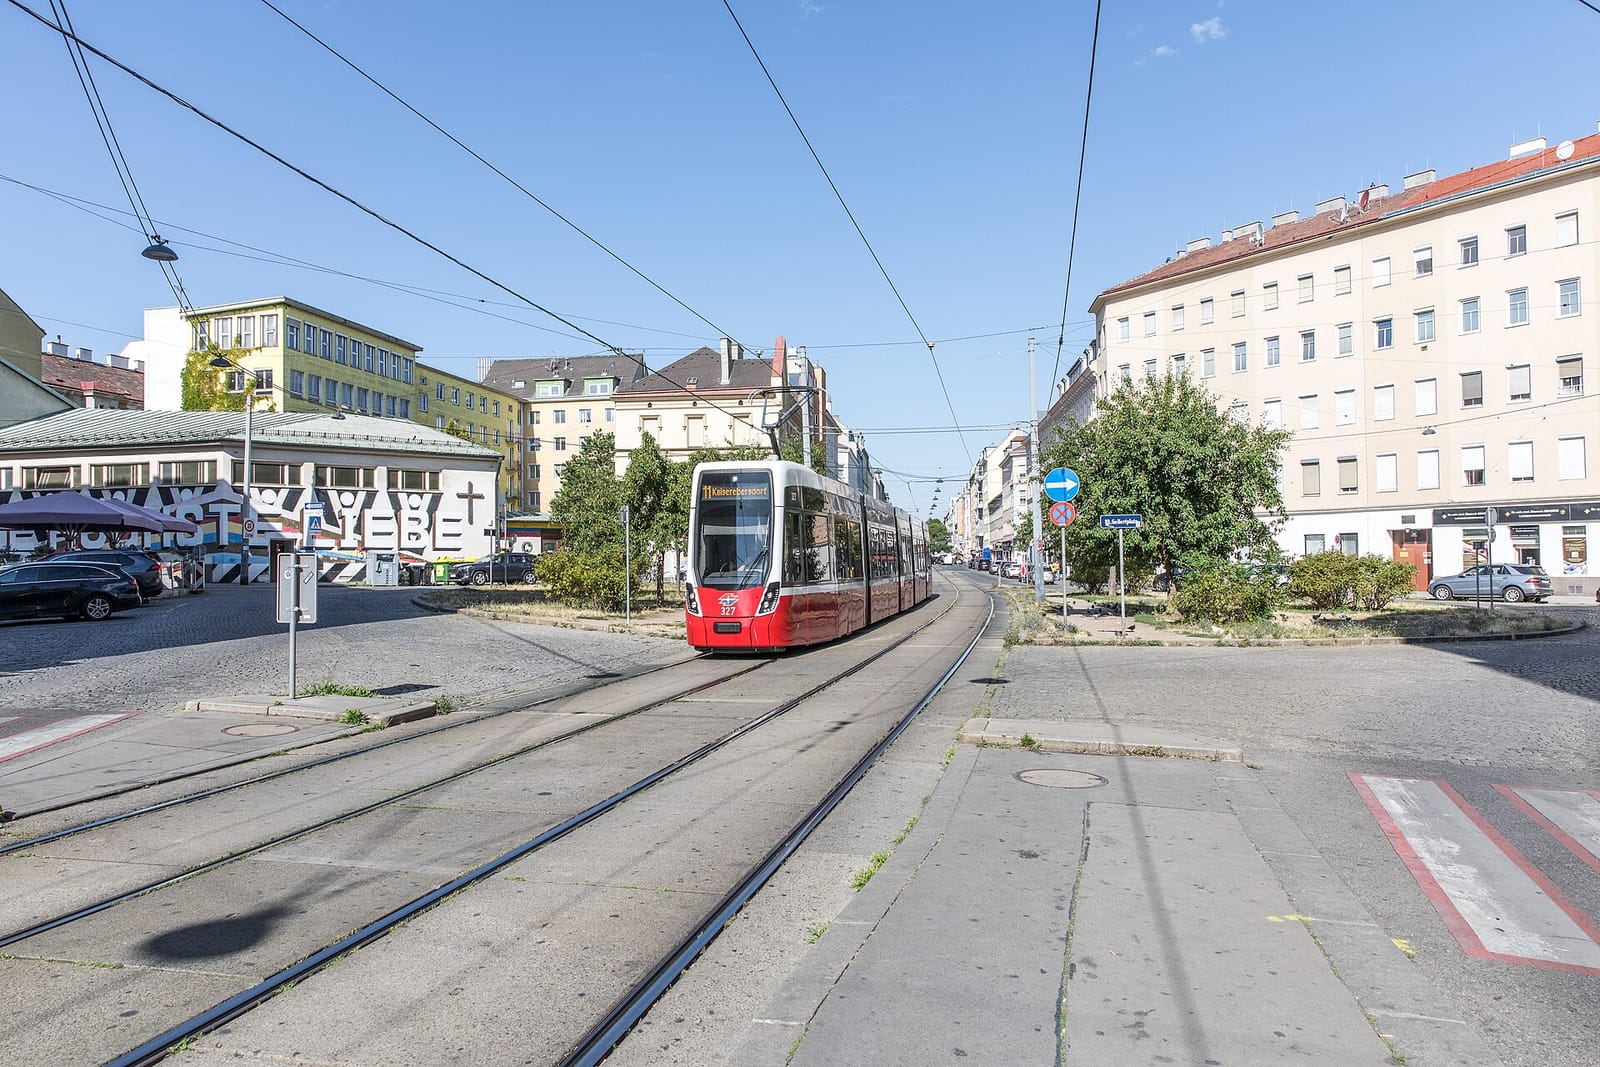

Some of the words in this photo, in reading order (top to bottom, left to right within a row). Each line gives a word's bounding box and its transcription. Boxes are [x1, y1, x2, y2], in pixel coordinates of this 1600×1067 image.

[703, 485, 711, 499] 11
[712, 486, 767, 496] Kaiserebersdorf
[720, 606, 736, 616] 327
